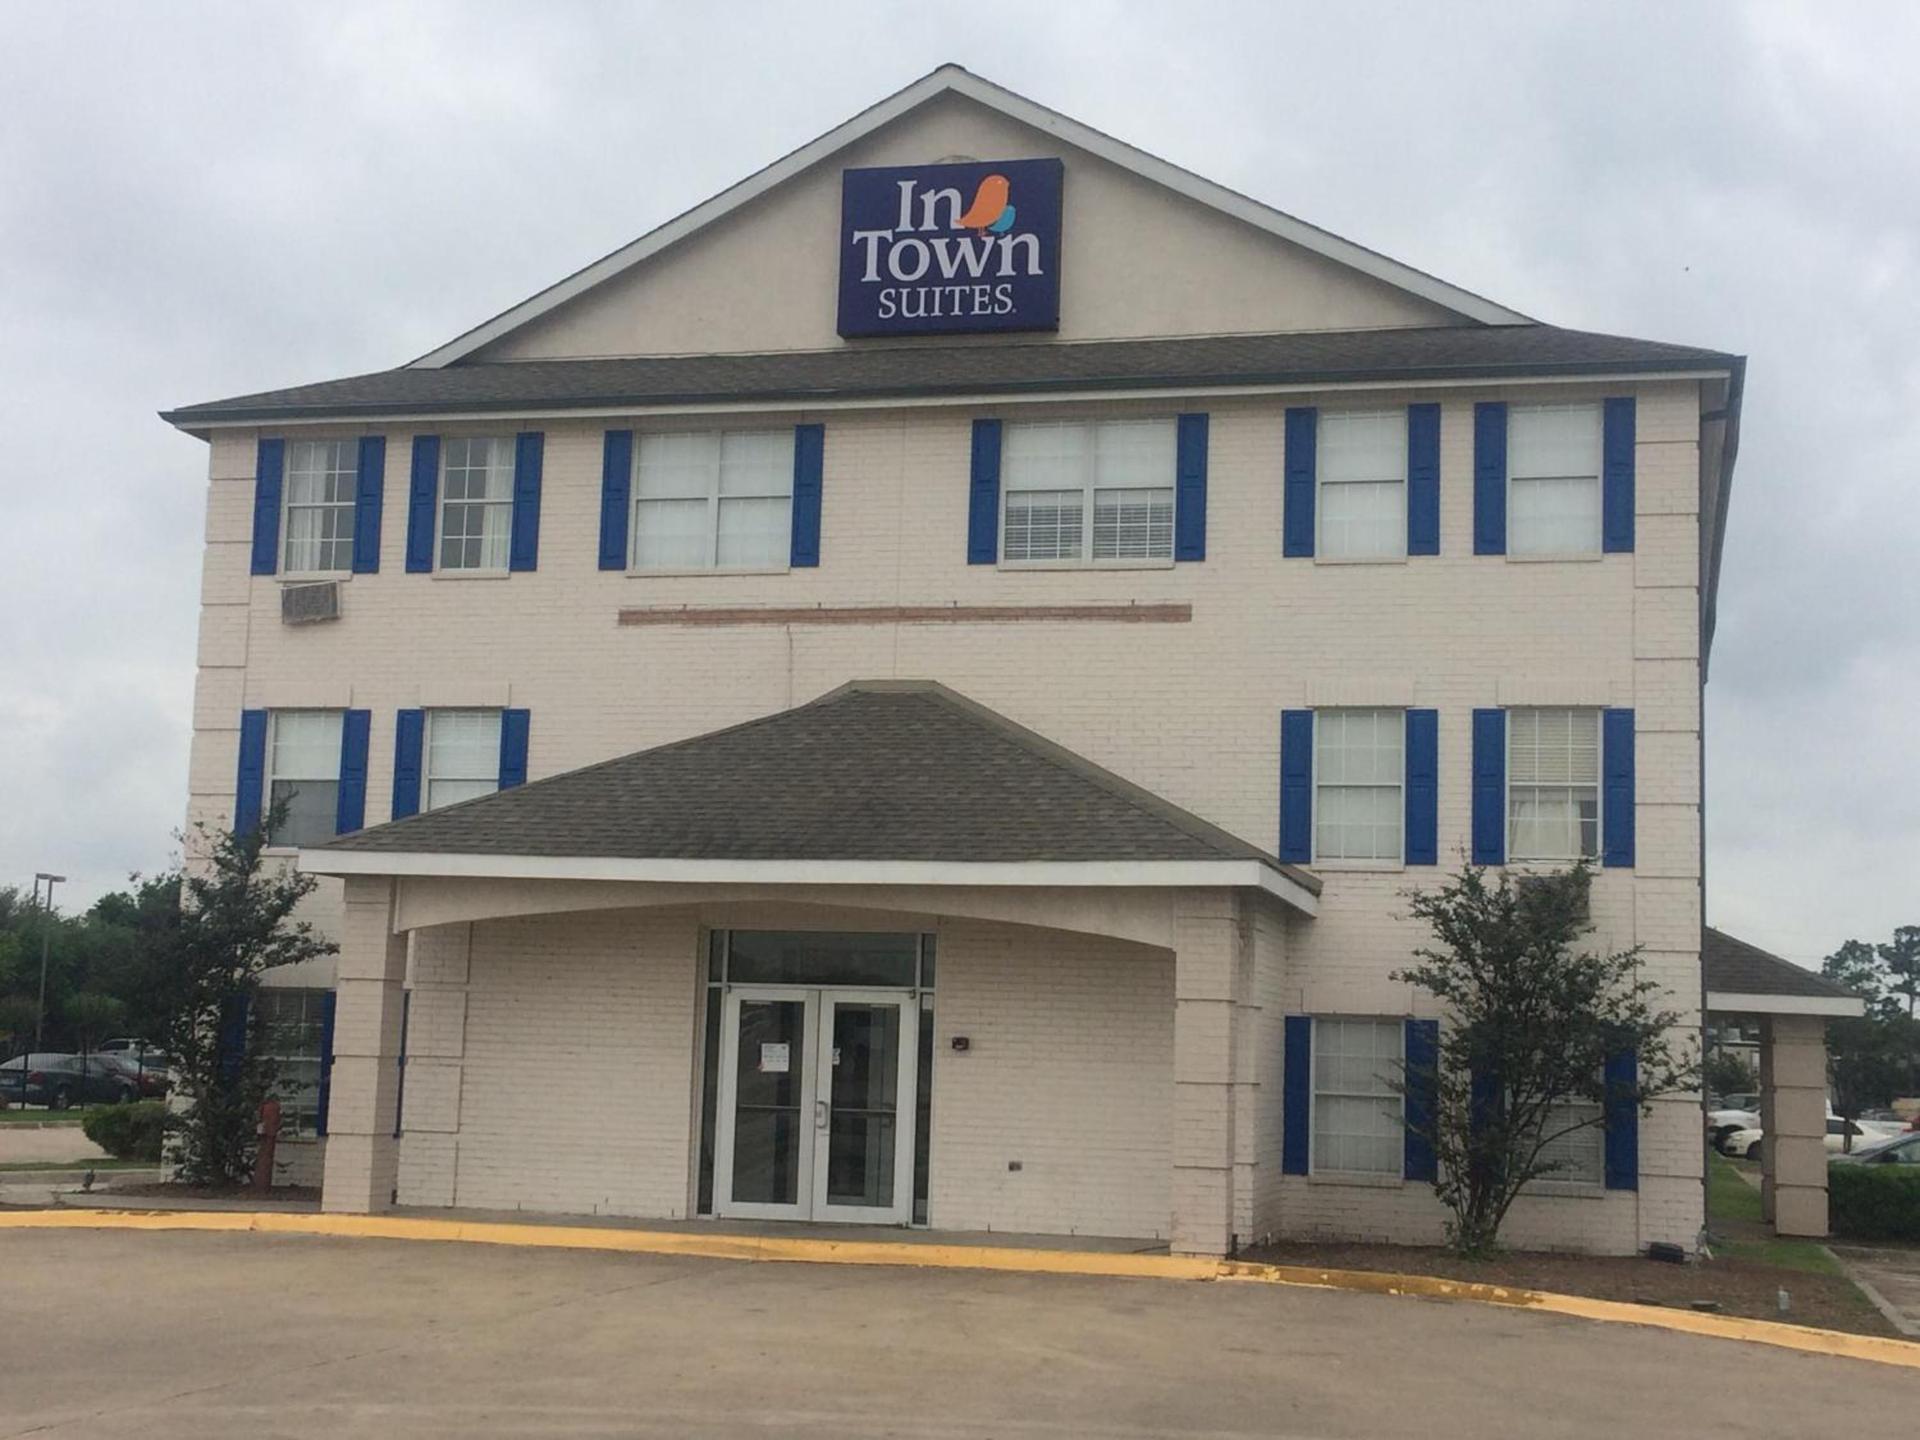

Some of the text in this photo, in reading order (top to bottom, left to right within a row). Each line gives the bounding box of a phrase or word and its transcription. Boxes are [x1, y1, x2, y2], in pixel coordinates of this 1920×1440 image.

[896, 180, 965, 232] In
[852, 229, 1044, 282] Town
[878, 284, 1013, 319] SUITES
